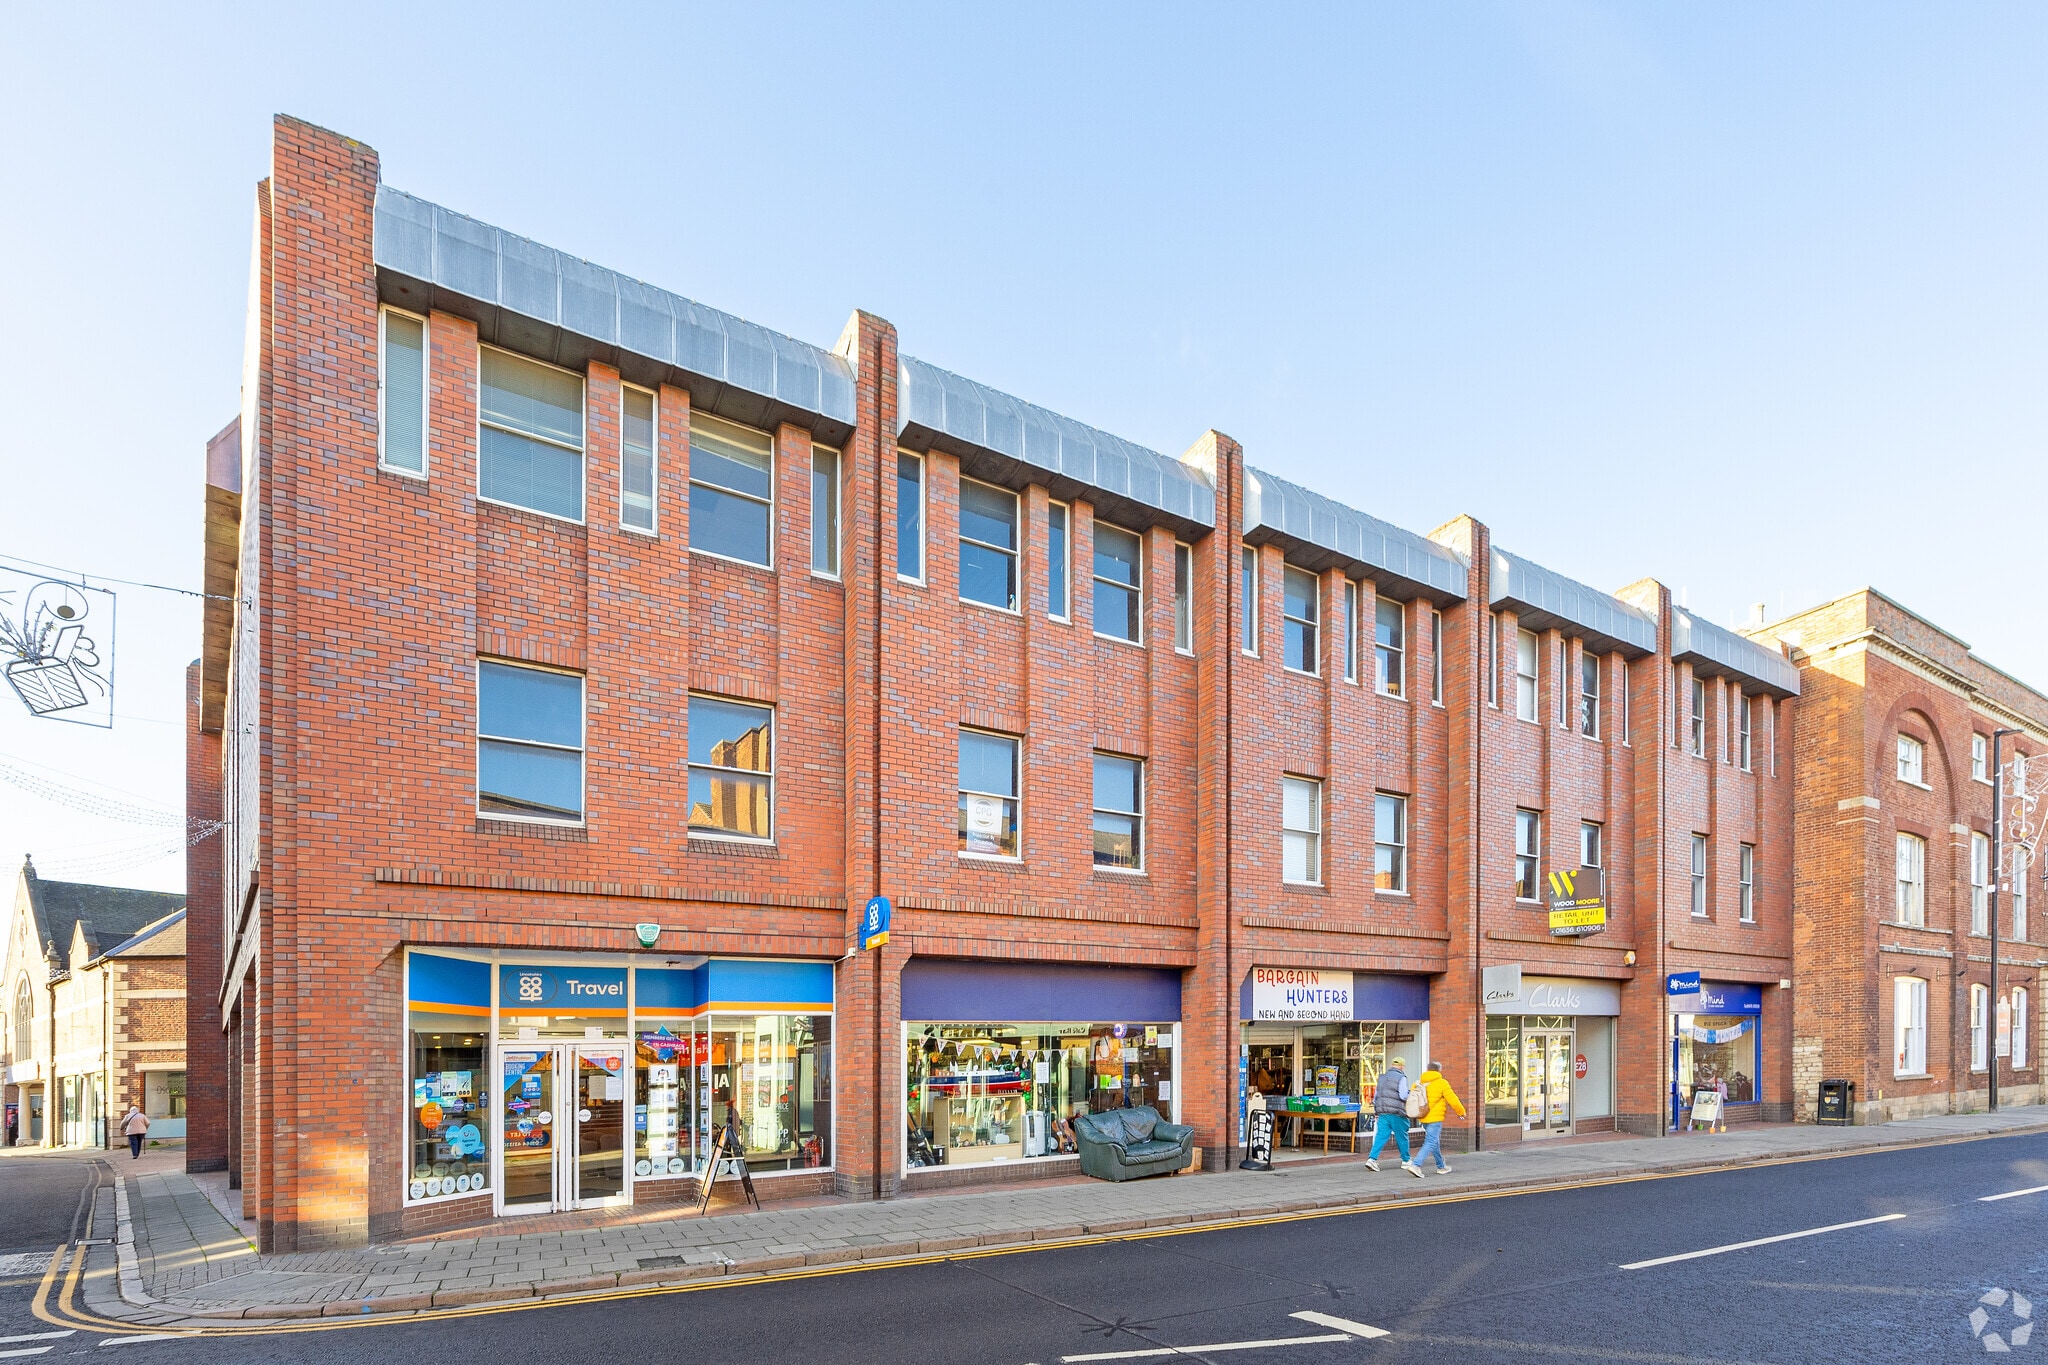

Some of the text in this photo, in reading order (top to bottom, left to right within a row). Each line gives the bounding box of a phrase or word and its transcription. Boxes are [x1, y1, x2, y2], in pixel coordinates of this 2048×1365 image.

[1257, 969, 1319, 987] BARGAIN
[566, 980, 623, 995] Travel
[1486, 990, 1514, 1000] Clarks
[1528, 982, 1580, 1008] Clarks
[1286, 989, 1348, 1006] HUNTERS
[1258, 1010, 1350, 1020] NEW AND SECOND HAND
